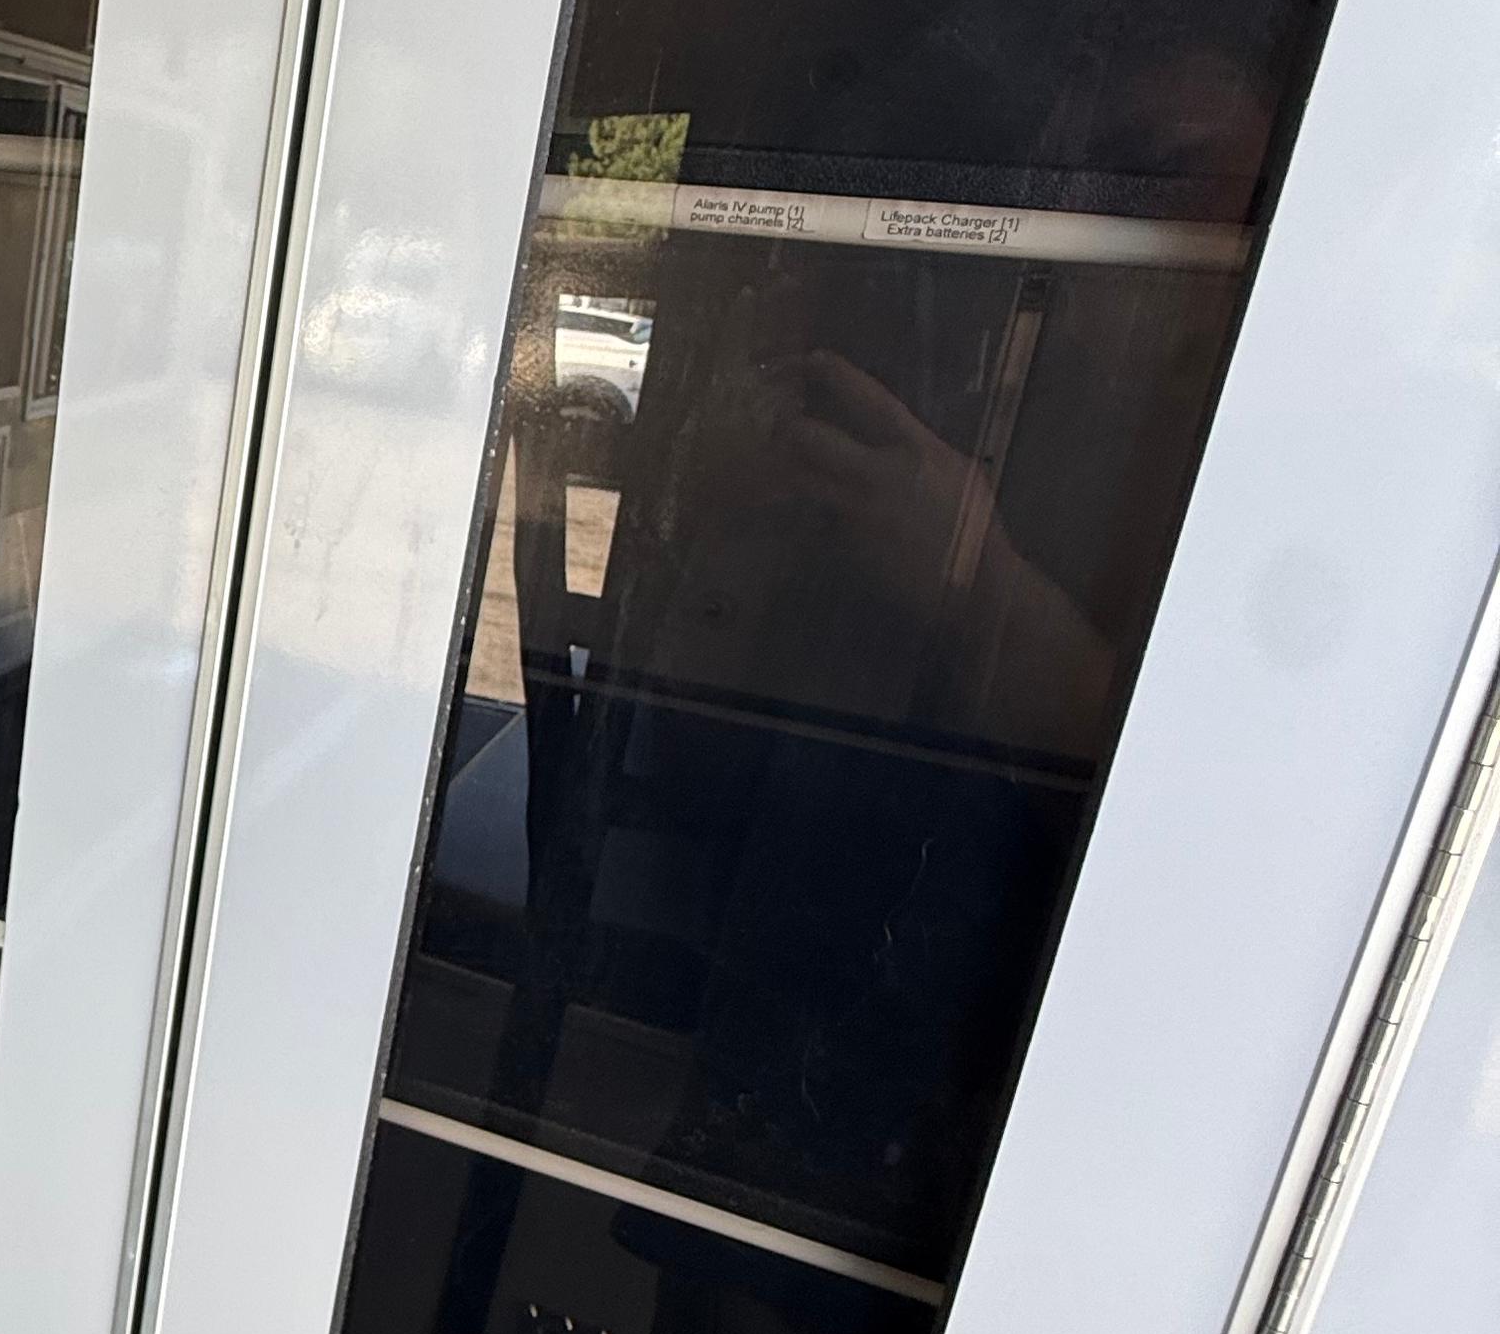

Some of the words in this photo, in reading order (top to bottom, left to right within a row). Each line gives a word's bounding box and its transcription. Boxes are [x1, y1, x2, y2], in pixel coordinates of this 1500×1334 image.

[693, 198, 729, 210] Alaris
[732, 201, 748, 212] IV
[748, 203, 785, 217] pump
[690, 211, 725, 224] pump
[727, 213, 784, 228] channels
[880, 210, 937, 225] Lifepack
[941, 214, 998, 230] Charger
[887, 223, 922, 237] Extra
[925, 226, 986, 241] batteries
[988, 229, 1008, 244] [2]
